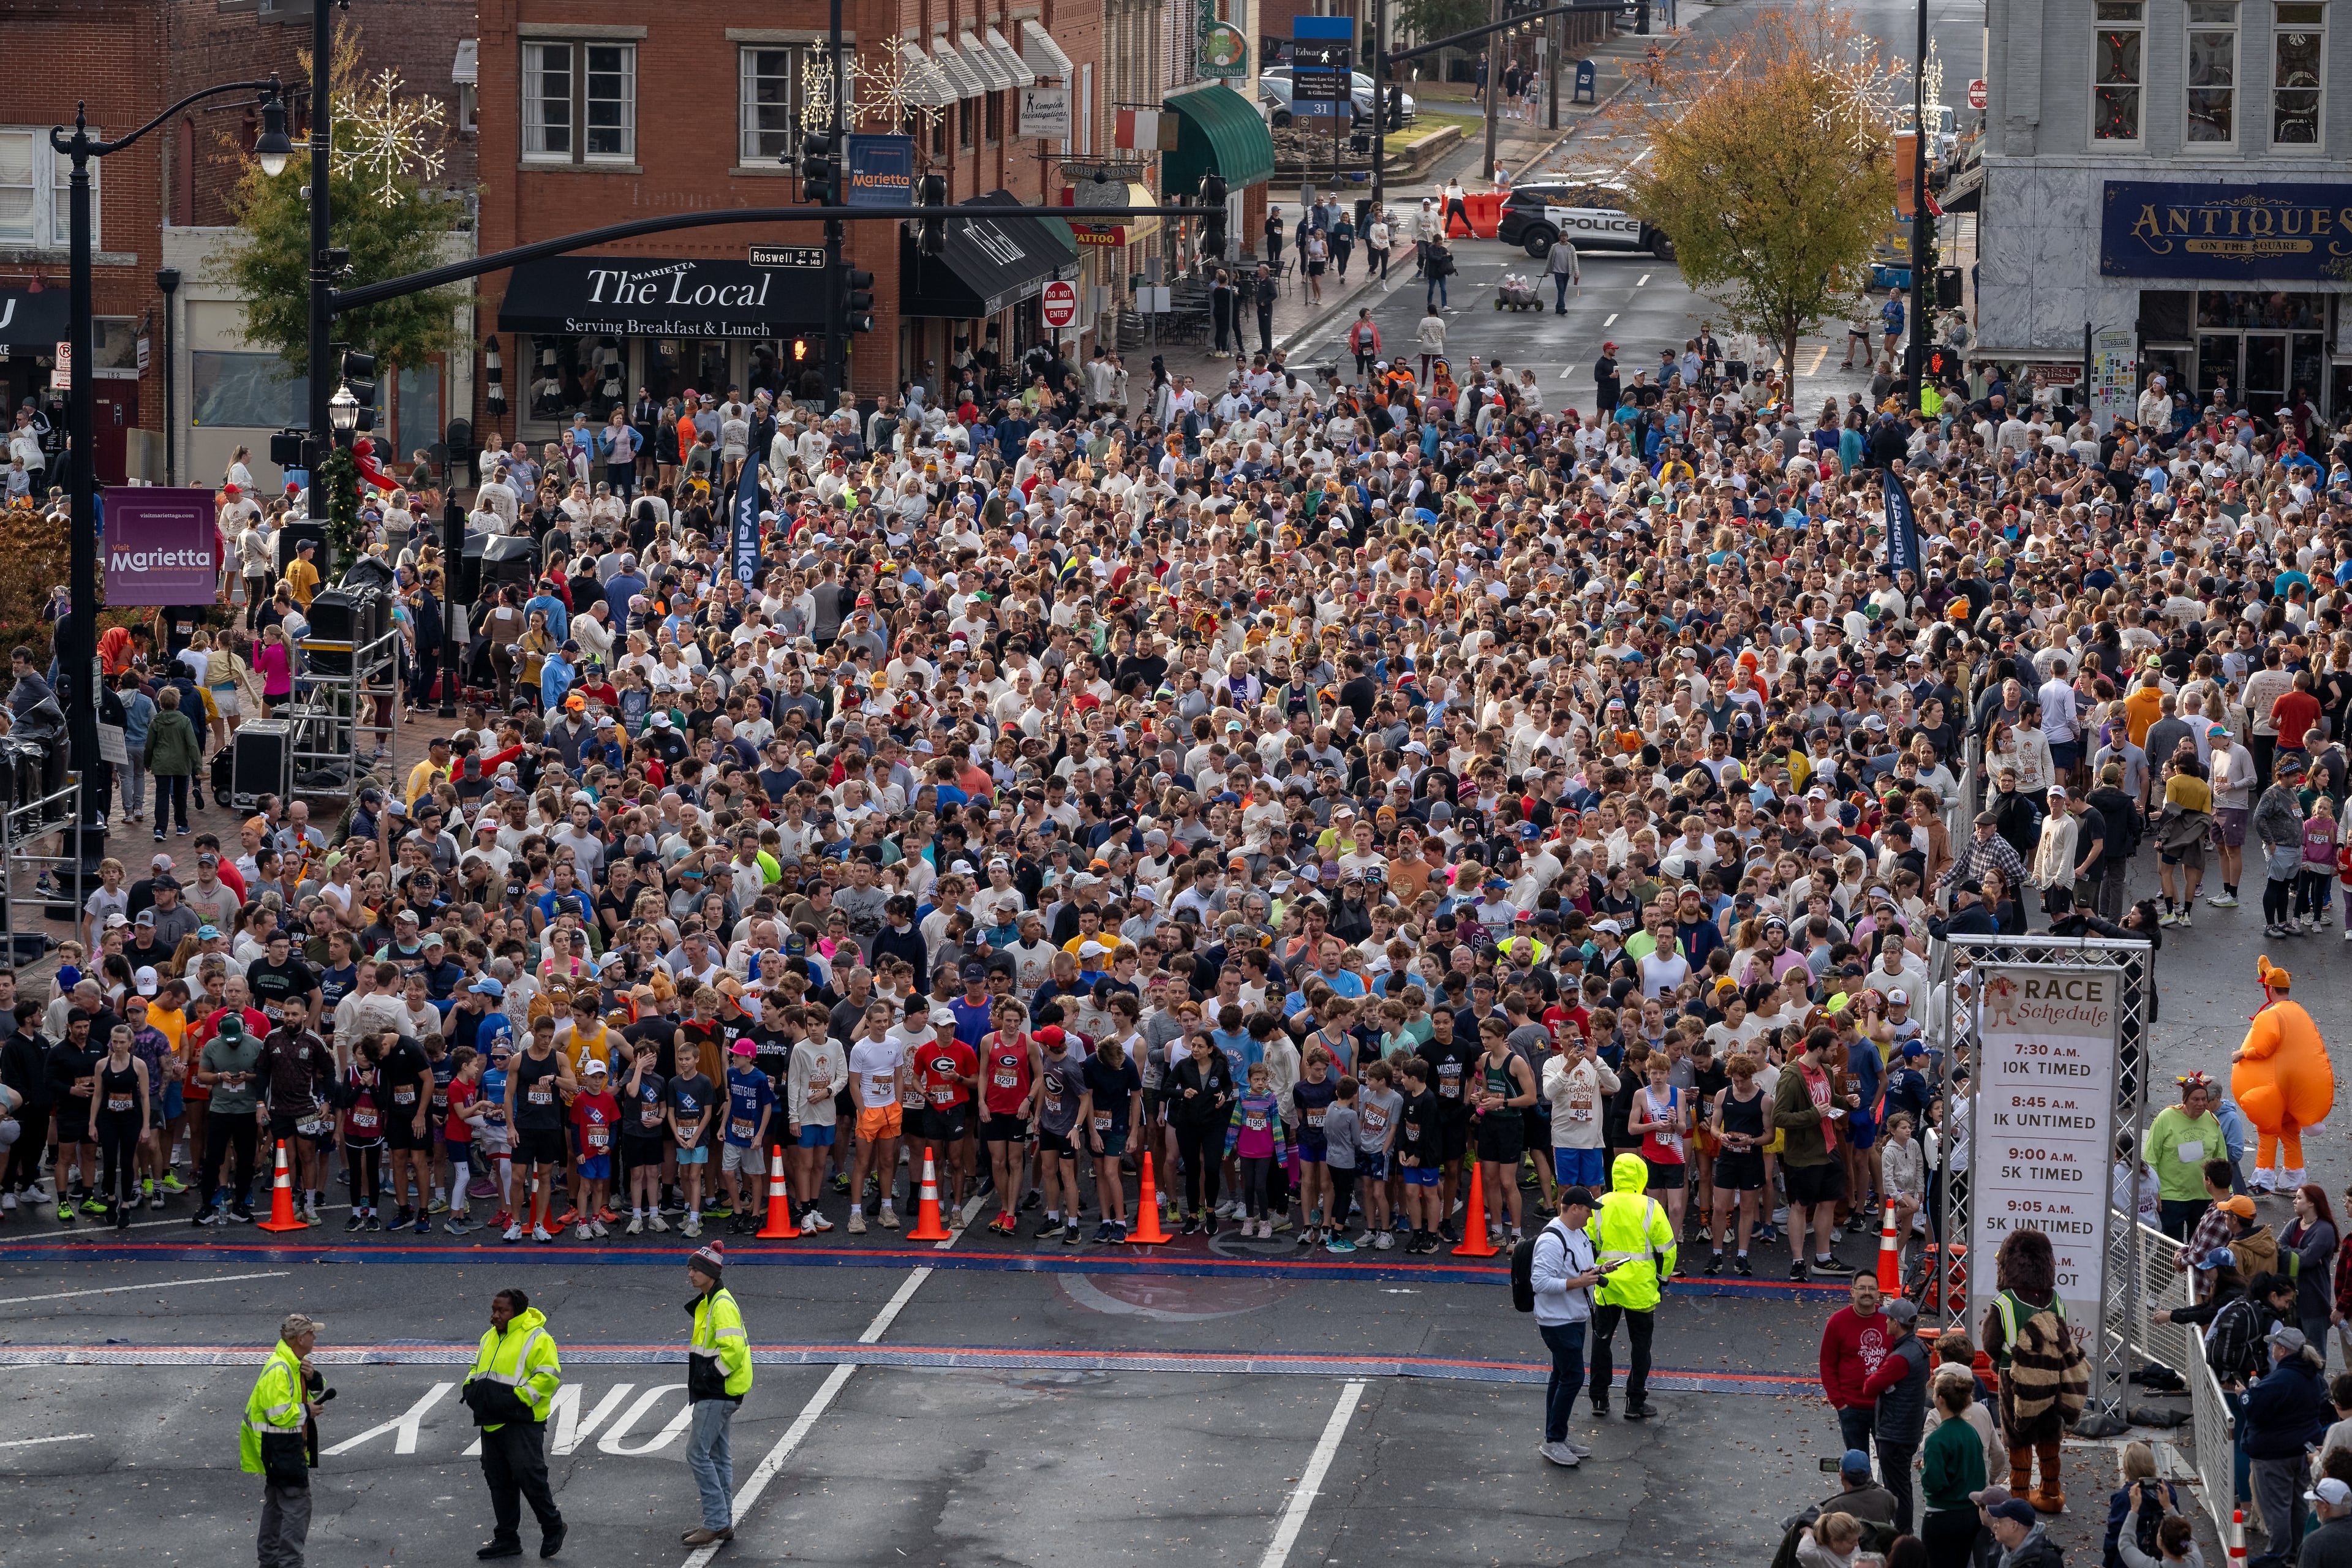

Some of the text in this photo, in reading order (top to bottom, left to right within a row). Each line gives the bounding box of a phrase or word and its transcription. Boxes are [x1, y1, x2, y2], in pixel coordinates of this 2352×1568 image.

[1199, 0, 1210, 64] KENS
[1198, 67, 1244, 75] JOHNNIE
[1021, 110, 1068, 119] Investigations,
[1314, 104, 1328, 114] 31
[1066, 165, 1138, 178] ROBISON'S
[852, 172, 910, 187] Marietta
[1561, 217, 1638, 232] POLICE
[2200, 241, 2297, 252] ON THE SQUARE
[753, 251, 793, 263] Roswell
[631, 262, 697, 282] MARIETTA
[587, 270, 772, 306] The Local
[565, 317, 771, 336] Serving Breakfast & Lunch
[1891, 493, 1904, 565] Runners
[110, 547, 210, 572] Marietta
[847, 902, 873, 914] Turkey
[291, 932, 305, 941] RUN
[2024, 979, 2103, 1002] RACE
[265, 1008, 283, 1017] 3621
[2018, 1002, 2108, 1028] Schedule
[756, 1044, 788, 1056] CHAMPS
[1227, 1049, 1243, 1062] HAWKS
[2015, 1044, 2080, 1057] 7:30 A.M.
[1437, 1063, 1463, 1075] MUSTANGS
[2003, 1061, 2090, 1076] 10K TIMED
[997, 1076, 1015, 1085] 9291
[396, 1093, 412, 1101] 3280
[530, 1093, 550, 1102] 4813
[744, 1086, 757, 1097] GAME
[1574, 1093, 1591, 1102] Jog
[2011, 1096, 2078, 1109] 8:45 A.M.
[1365, 1110, 1383, 1124] 3540
[1574, 1109, 1588, 1117] 454
[356, 1115, 375, 1124] 3282
[1994, 1113, 2095, 1129] 1K UNTIMED
[306, 1123, 315, 1131] 49
[734, 1124, 751, 1135] 3045
[590, 1136, 607, 1144] 3100
[1656, 1133, 1673, 1142] 3813
[2008, 1147, 2076, 1163] 9:00 A.M.
[2001, 1166, 2082, 1182] 5K TIMED
[2007, 1200, 2074, 1214] 9:05 A.M.
[1986, 1217, 2093, 1234] 5K UNTIMED
[2067, 1325, 2092, 1344] og
[1858, 1347, 1887, 1358] Gobble
[1864, 1355, 1882, 1366] Jog
[320, 1382, 695, 1457] ONY
